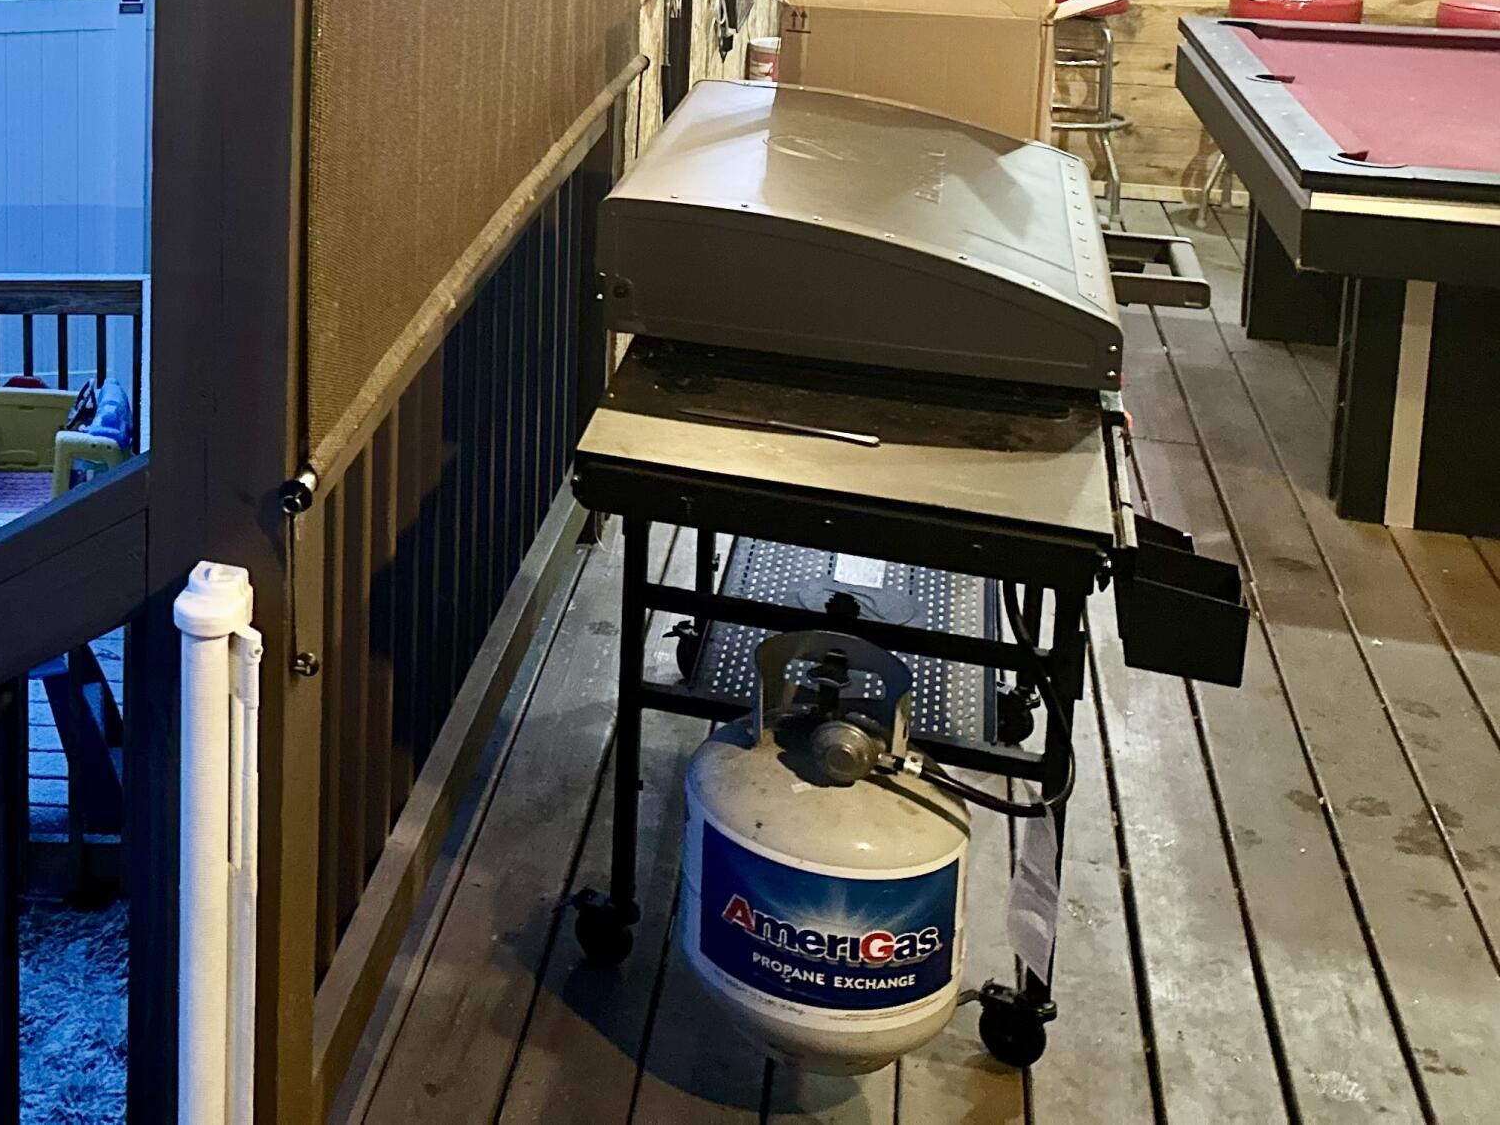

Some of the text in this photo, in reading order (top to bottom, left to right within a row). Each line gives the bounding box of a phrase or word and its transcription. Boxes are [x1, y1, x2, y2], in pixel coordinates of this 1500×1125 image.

[721, 893, 941, 965] AmeriGas
[752, 952, 916, 990] PROPANE EXCHANGE
